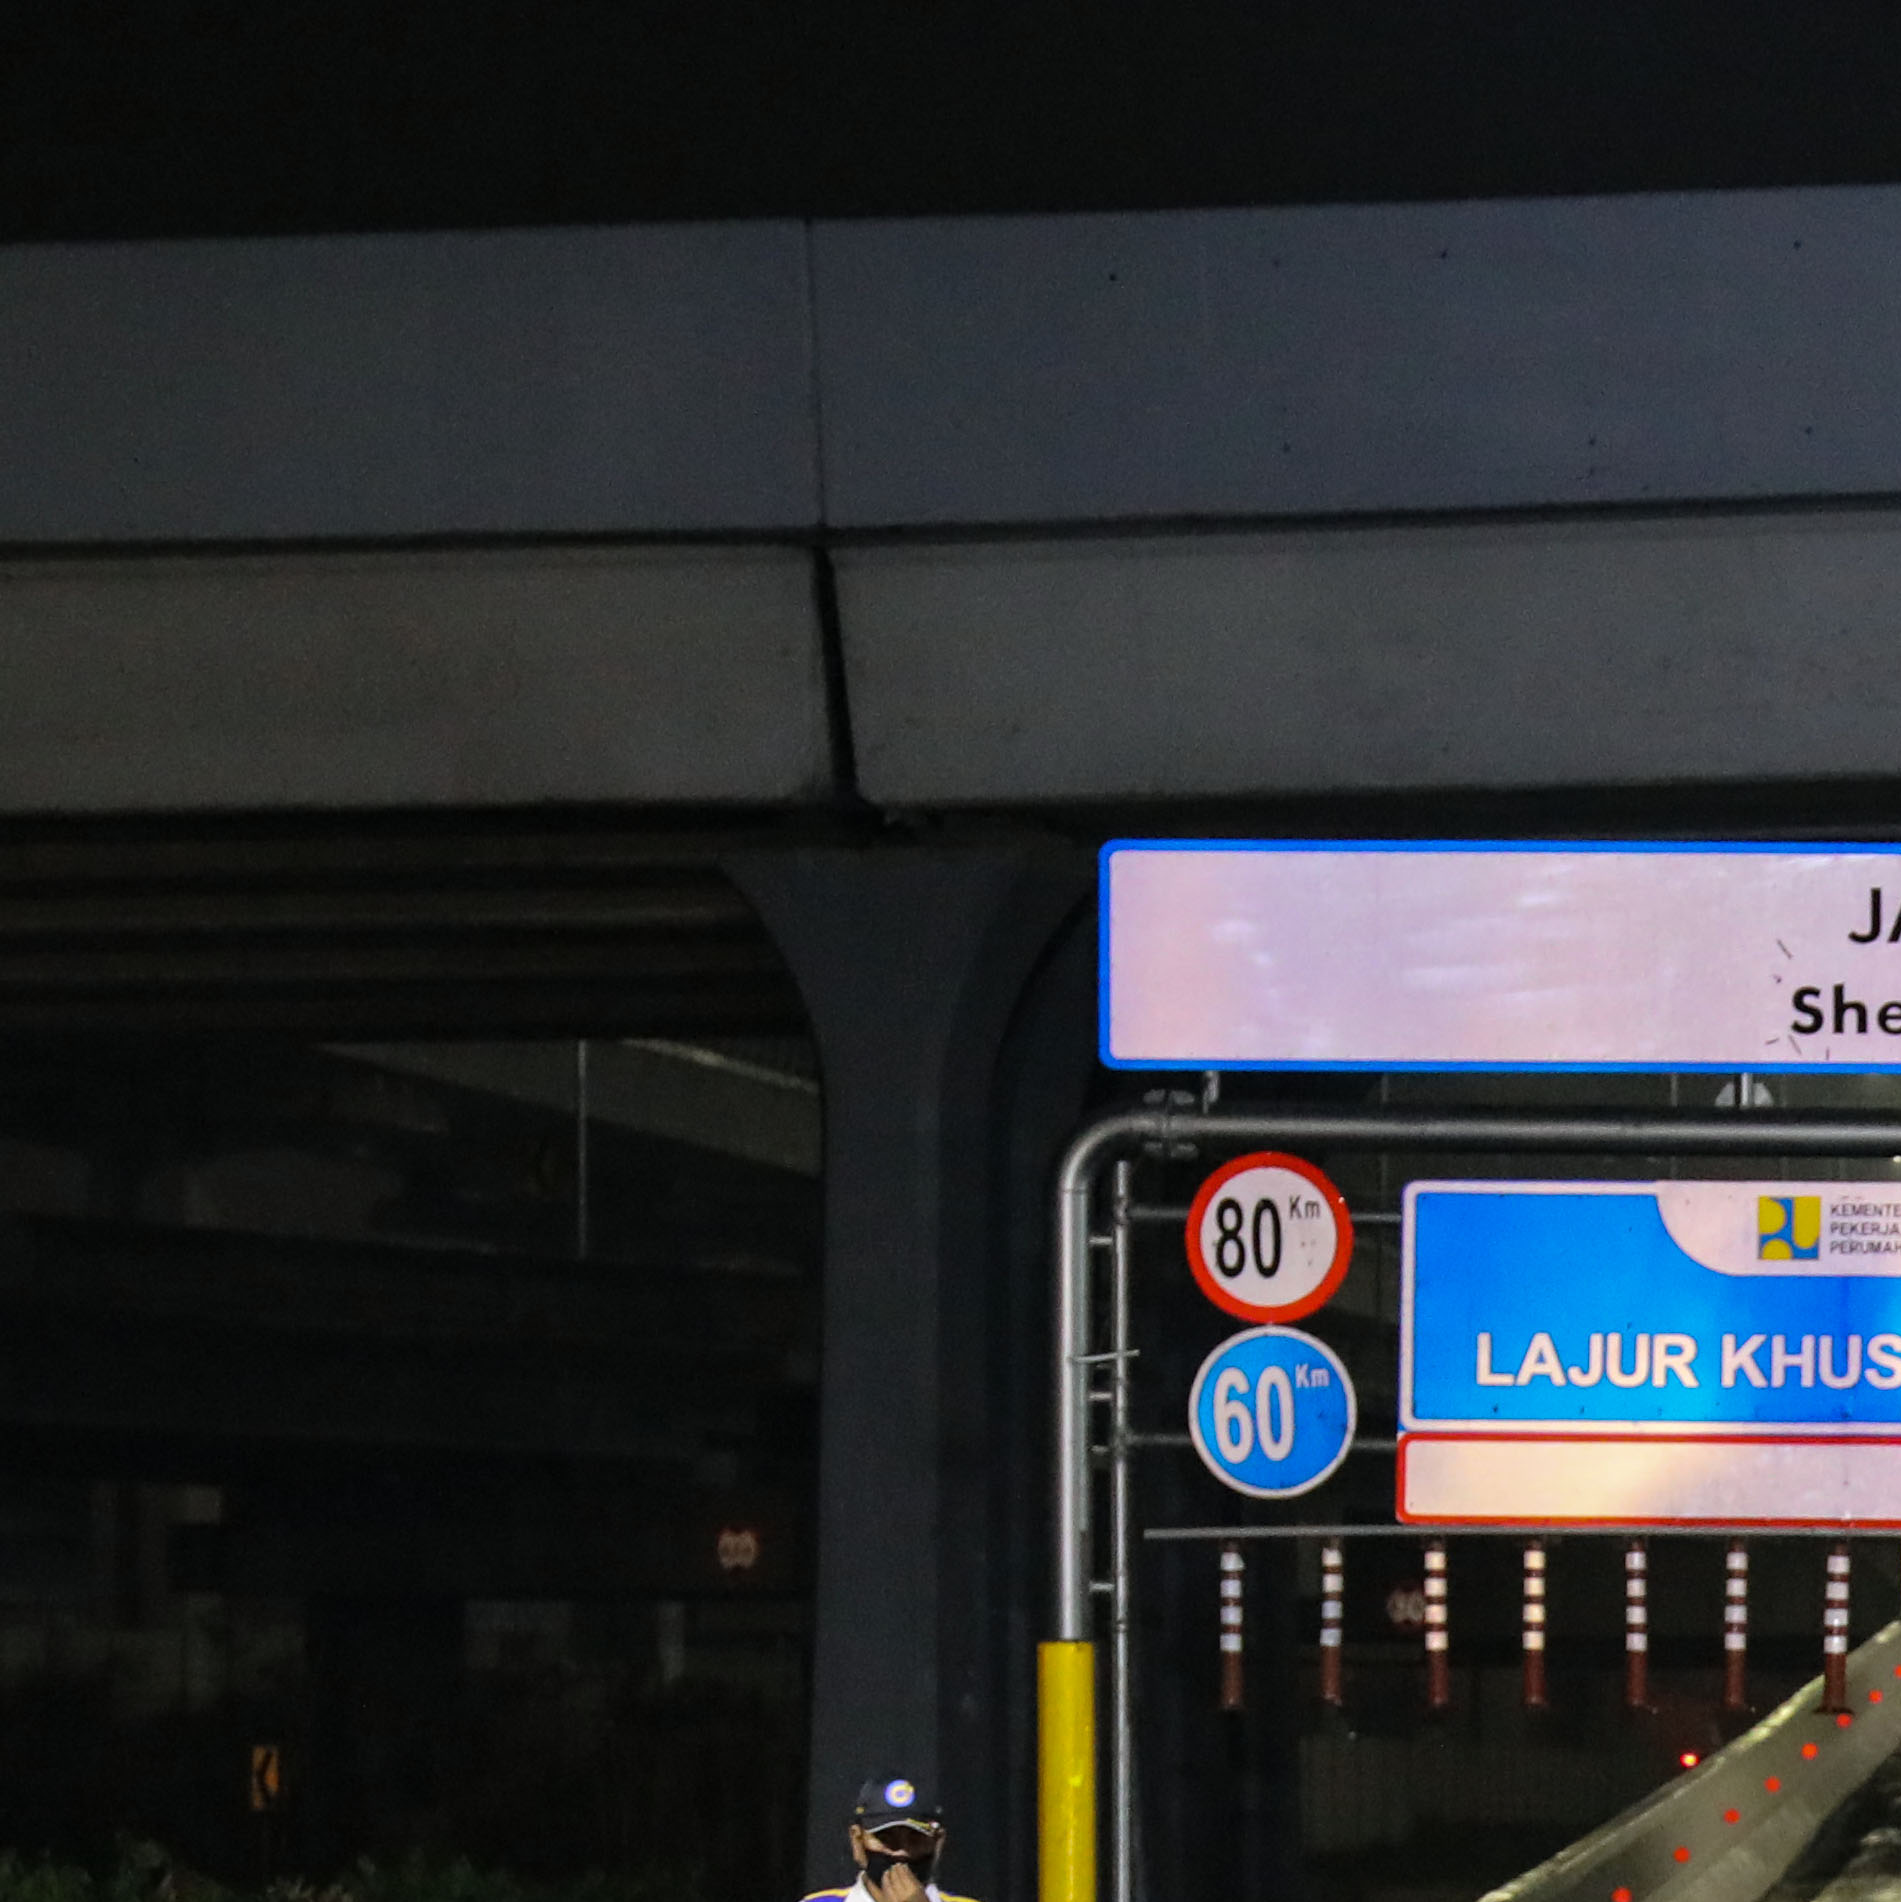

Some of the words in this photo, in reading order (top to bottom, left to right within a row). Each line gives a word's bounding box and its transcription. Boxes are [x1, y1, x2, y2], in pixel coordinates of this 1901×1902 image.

[1215, 1197, 1282, 1279] 80
[1288, 1195, 1321, 1220] Km
[1476, 1332, 1699, 1389] LAJUR
[1212, 1364, 1296, 1465] 60
[1294, 1362, 1331, 1389] Km
